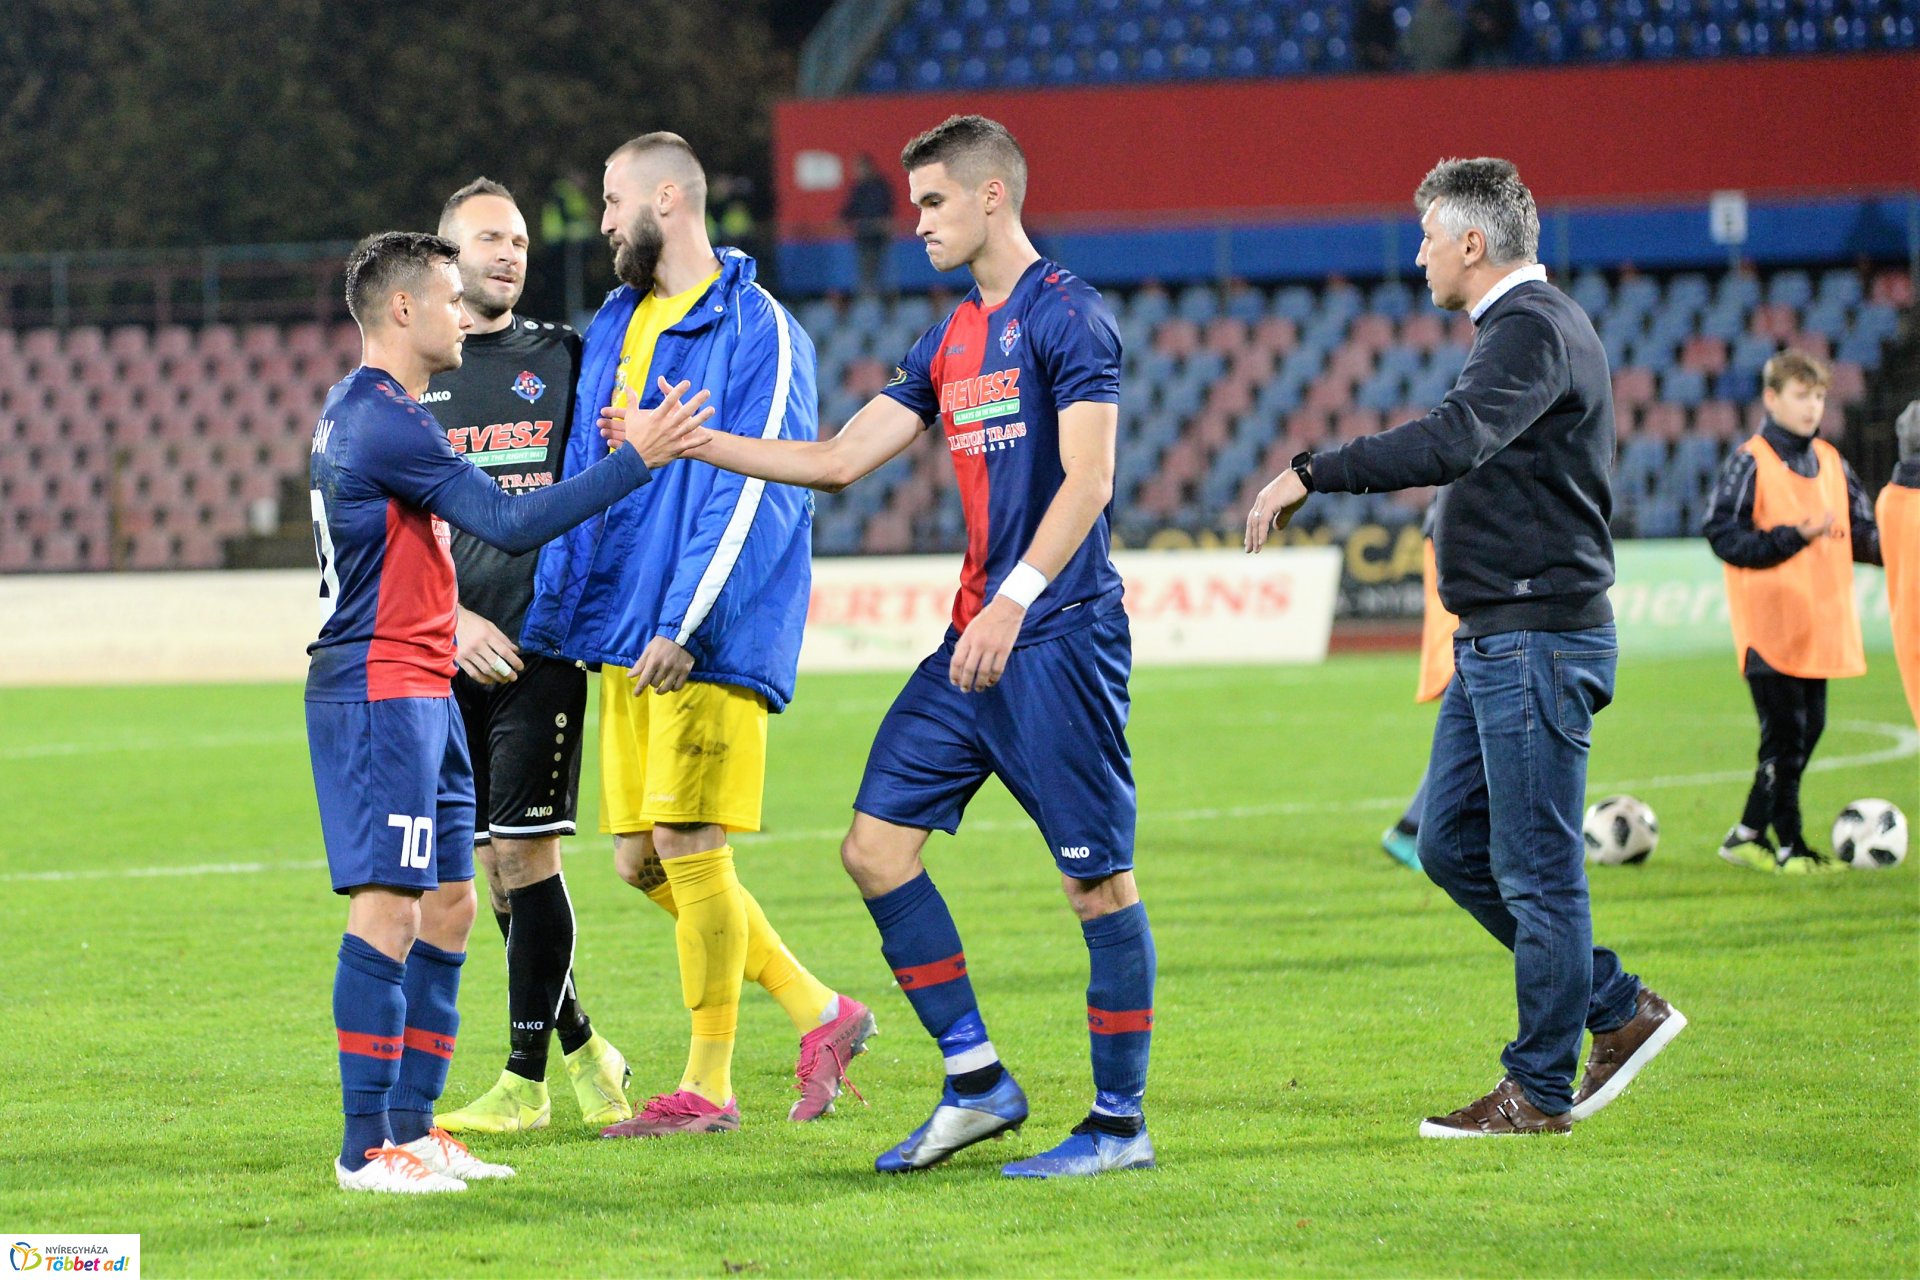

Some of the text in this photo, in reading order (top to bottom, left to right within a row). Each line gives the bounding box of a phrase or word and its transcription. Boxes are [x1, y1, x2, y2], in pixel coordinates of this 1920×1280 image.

[418, 390, 452, 404] JAKO
[446, 420, 553, 453] EVESZ
[498, 471, 554, 488] TRANS
[525, 805, 553, 818] JAKO
[387, 813, 433, 869] 70
